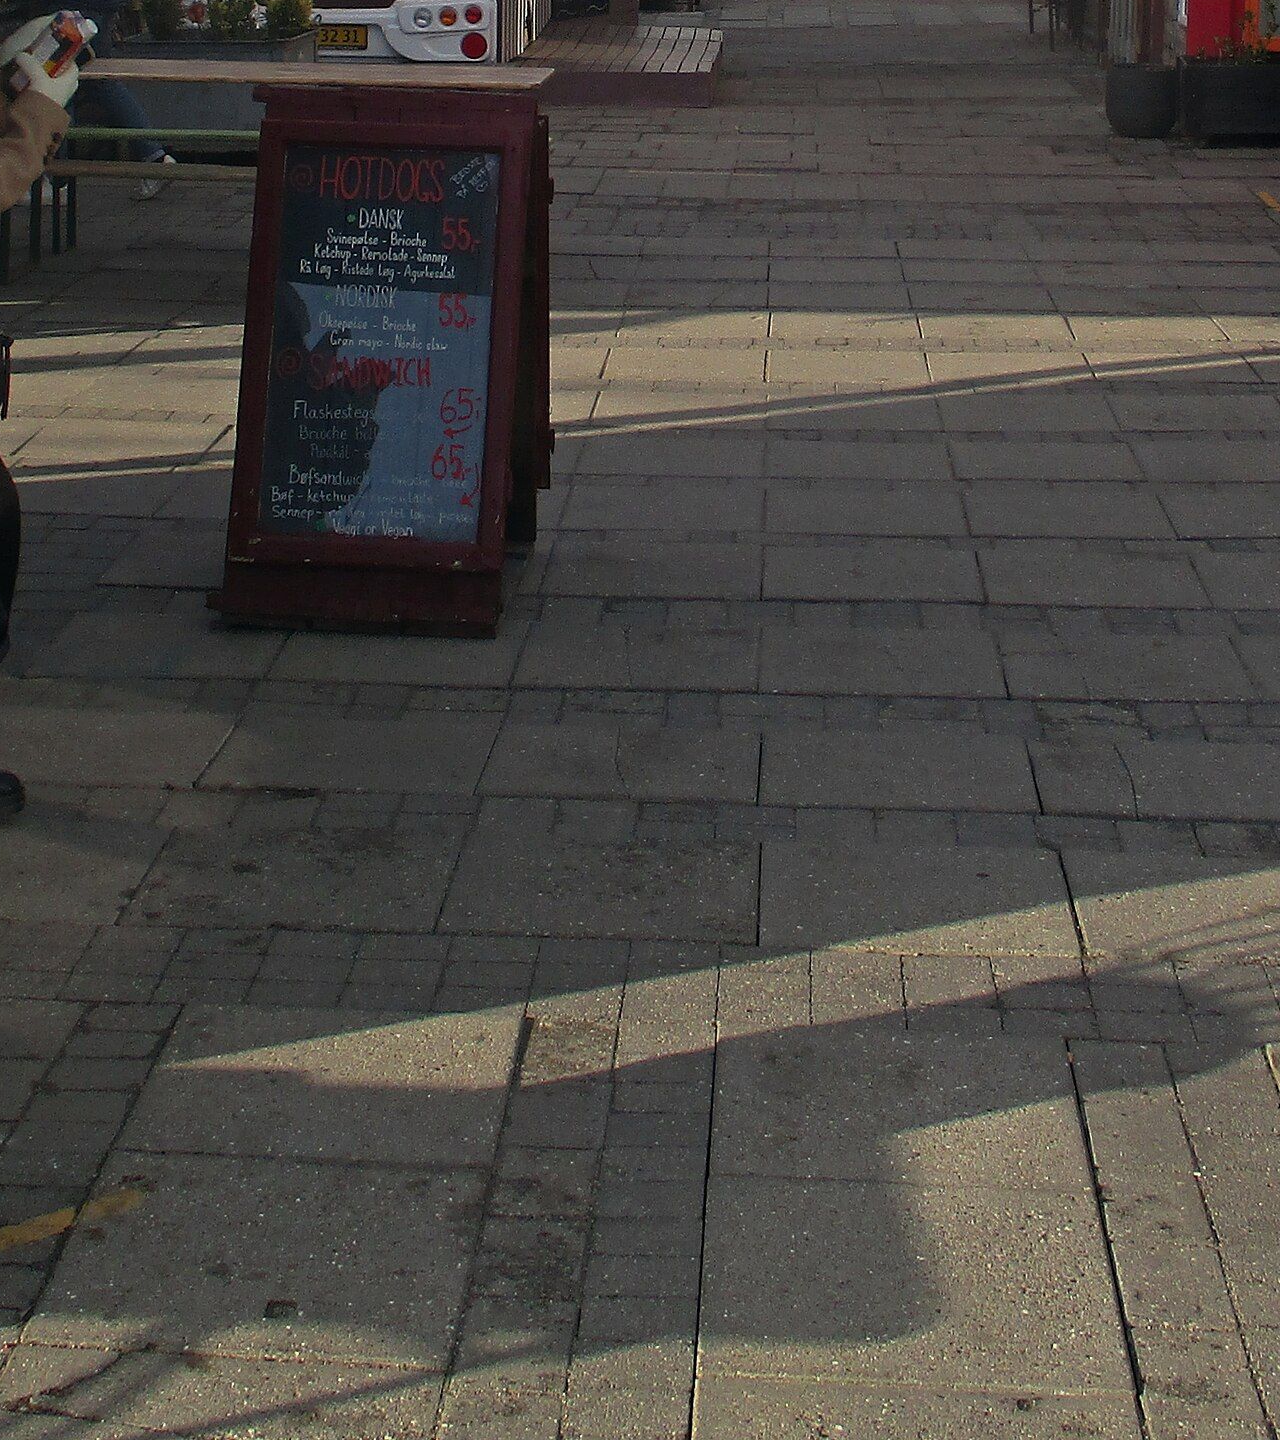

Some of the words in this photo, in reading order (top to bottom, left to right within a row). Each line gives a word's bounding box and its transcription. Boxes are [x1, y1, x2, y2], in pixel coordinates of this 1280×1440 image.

[320, 154, 446, 203] HOTDOGS
[357, 207, 405, 231] DANSK
[326, 227, 379, 246] Svinepølse
[389, 231, 428, 248] Brioche
[313, 243, 351, 260] Ketchup
[334, 283, 399, 309] NORDISK
[382, 315, 417, 332] Brioche
[307, 351, 433, 391] SANDWICH
[270, 486, 295, 505] Bøf
[271, 505, 317, 523] Sennep
[381, 518, 414, 540] Vegan
